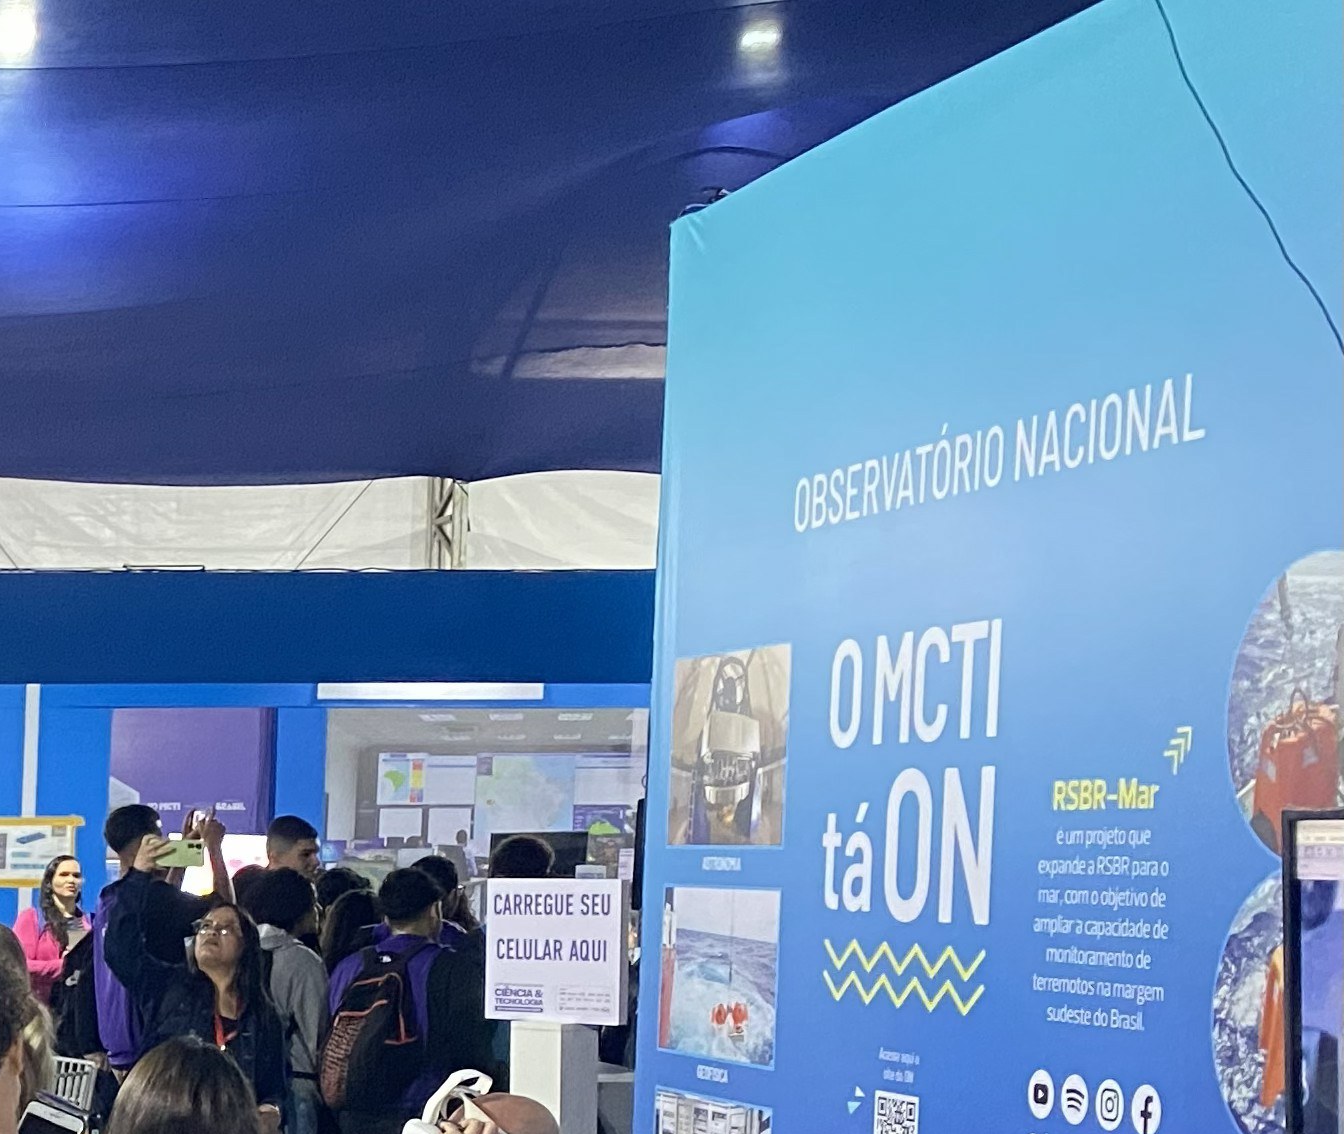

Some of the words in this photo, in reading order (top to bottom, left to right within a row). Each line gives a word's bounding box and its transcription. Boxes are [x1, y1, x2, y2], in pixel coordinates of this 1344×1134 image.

[794, 422, 1005, 533] OBSERVATÓRIO
[1014, 373, 1206, 482] NACIONAL
[830, 638, 863, 749] O
[871, 618, 1002, 745] MCTI
[1053, 778, 1160, 811] RSBR-Mar
[822, 802, 873, 912] tá
[884, 765, 996, 925] ON
[1066, 830, 1084, 844] um
[1086, 826, 1126, 849] projeto
[1128, 829, 1151, 849] que
[1038, 855, 1086, 879] expande
[1087, 860, 1095, 875] a
[1097, 856, 1131, 875] RSBR
[1132, 860, 1158, 879] para
[1160, 861, 1169, 876] o
[493, 893, 574, 916] CARREGUE
[580, 893, 611, 916] SEU
[1038, 888, 1064, 906] mar,
[1064, 889, 1089, 904] com
[1090, 890, 1099, 905] o
[1100, 886, 1149, 911] objetivo
[1150, 887, 1167, 907] de
[1033, 914, 1074, 937] ampliar
[1075, 919, 1083, 934] a
[1084, 917, 1151, 940] capacidade
[1152, 919, 1169, 939] de
[496, 938, 563, 961] CELULAR
[569, 939, 607, 962] AQUI
[1046, 945, 1134, 968] monitoramento
[1135, 949, 1152, 969] de
[1032, 973, 1095, 995] terremotos
[1096, 981, 1111, 997] na
[1112, 982, 1165, 1005] margem
[1046, 1003, 1092, 1026] sudeste
[1093, 1008, 1109, 1026] do
[1110, 1008, 1145, 1031] Brasil.
